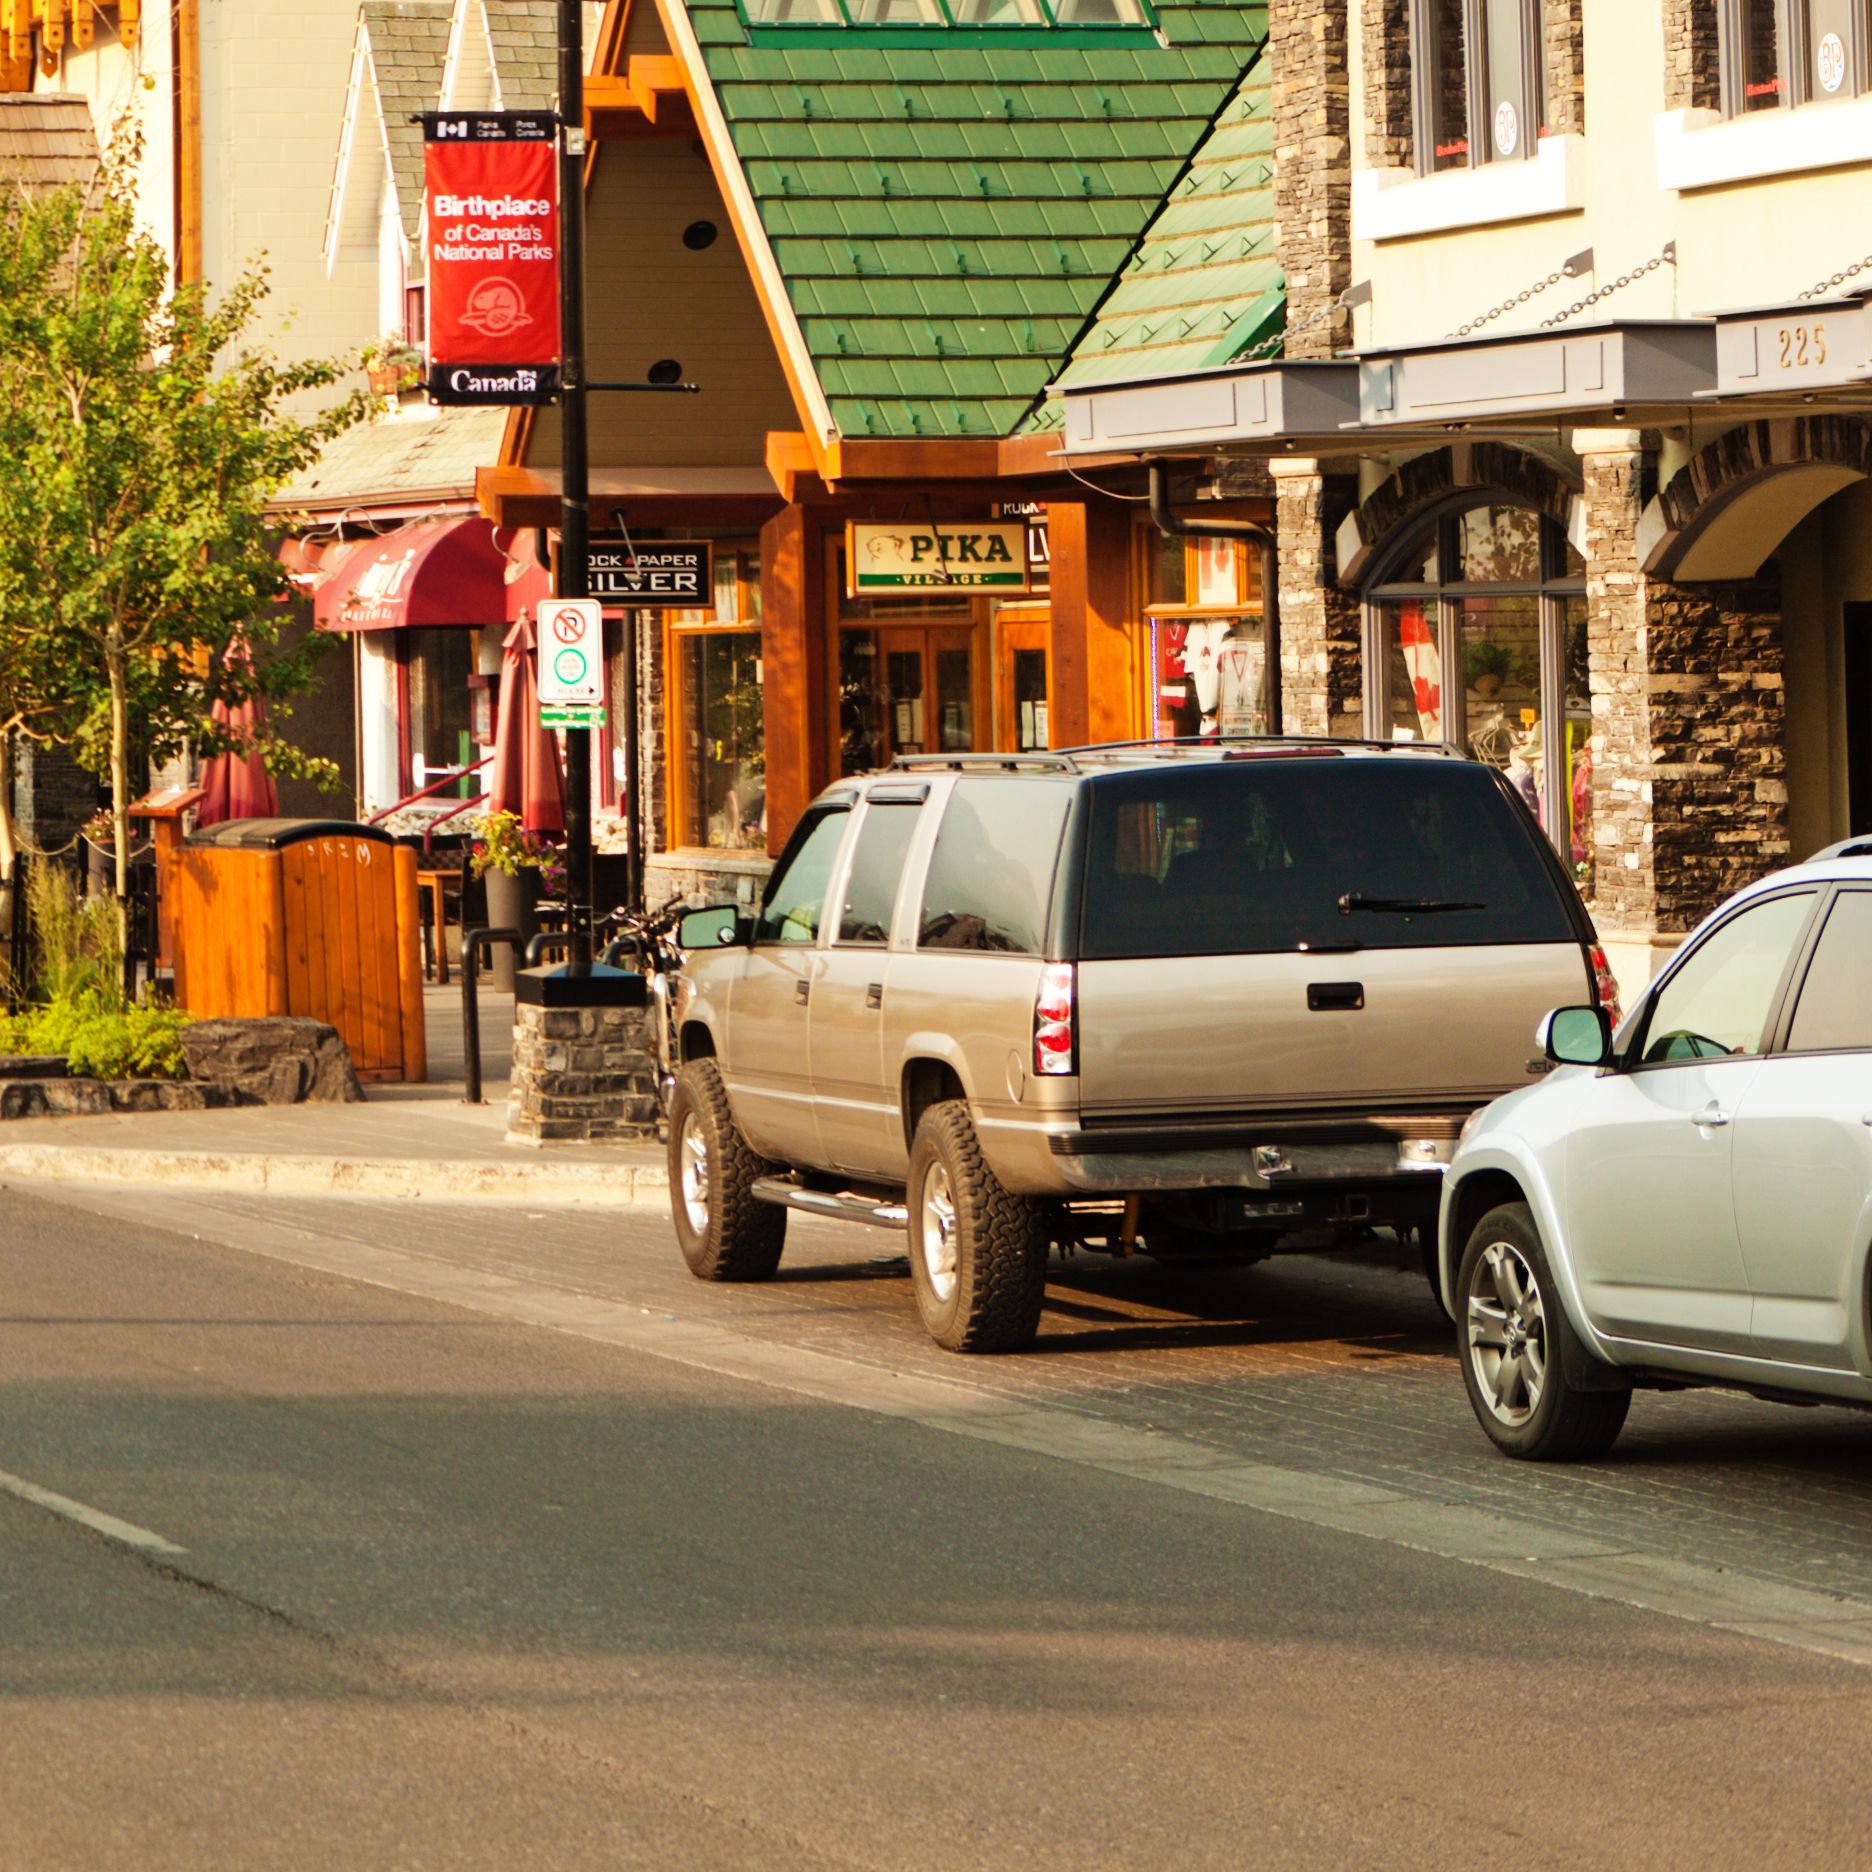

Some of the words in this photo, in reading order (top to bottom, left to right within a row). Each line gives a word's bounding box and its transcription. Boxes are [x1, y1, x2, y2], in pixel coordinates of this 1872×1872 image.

[477, 129, 506, 137] Canada
[516, 129, 545, 137] Canada
[434, 195, 550, 221] Birthplace
[444, 224, 463, 241] of
[466, 224, 543, 241] Canada's
[434, 243, 504, 260] National
[508, 243, 553, 260] Parks
[1779, 324, 1826, 368] 225
[450, 370, 537, 392] Canada
[909, 534, 1013, 563] PIKA
[588, 555, 622, 567] OCK
[638, 555, 698, 566] PAPER
[588, 573, 698, 591] ILVER
[902, 574, 982, 585] VILGE
